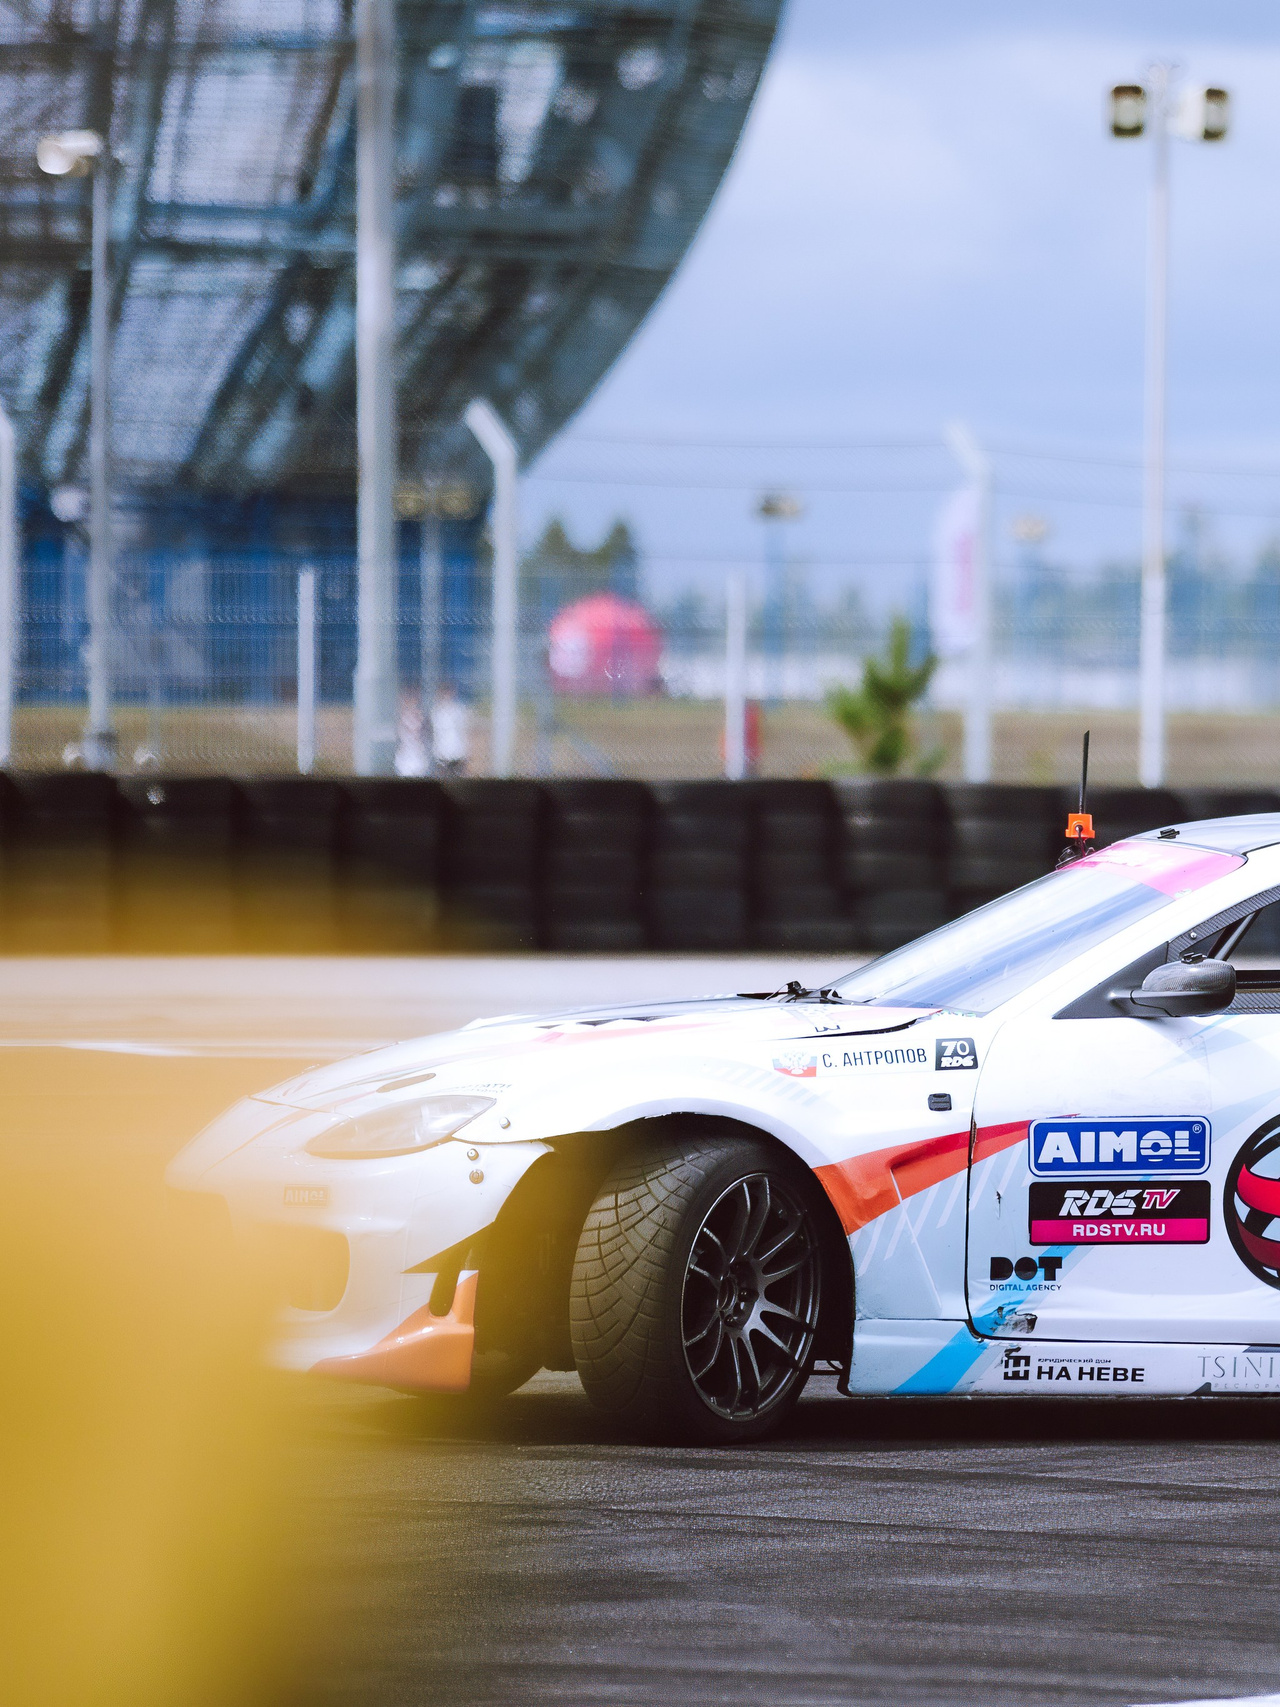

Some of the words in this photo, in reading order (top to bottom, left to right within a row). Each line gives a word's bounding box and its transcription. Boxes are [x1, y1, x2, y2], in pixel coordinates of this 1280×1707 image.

[940, 1040, 970, 1057] 70
[822, 1053, 838, 1068] С.
[843, 1047, 927, 1067] АНТРОПОВ
[1037, 1130, 1200, 1164] AIMOL
[1072, 1223, 1166, 1237] RDSTV.RU
[989, 1256, 1063, 1281] DOT
[989, 1284, 1024, 1292] DIGITAL
[1025, 1284, 1062, 1292] AGENCY
[1036, 1366, 1072, 1381] НА
[1077, 1366, 1145, 1382] НЕВЕ
